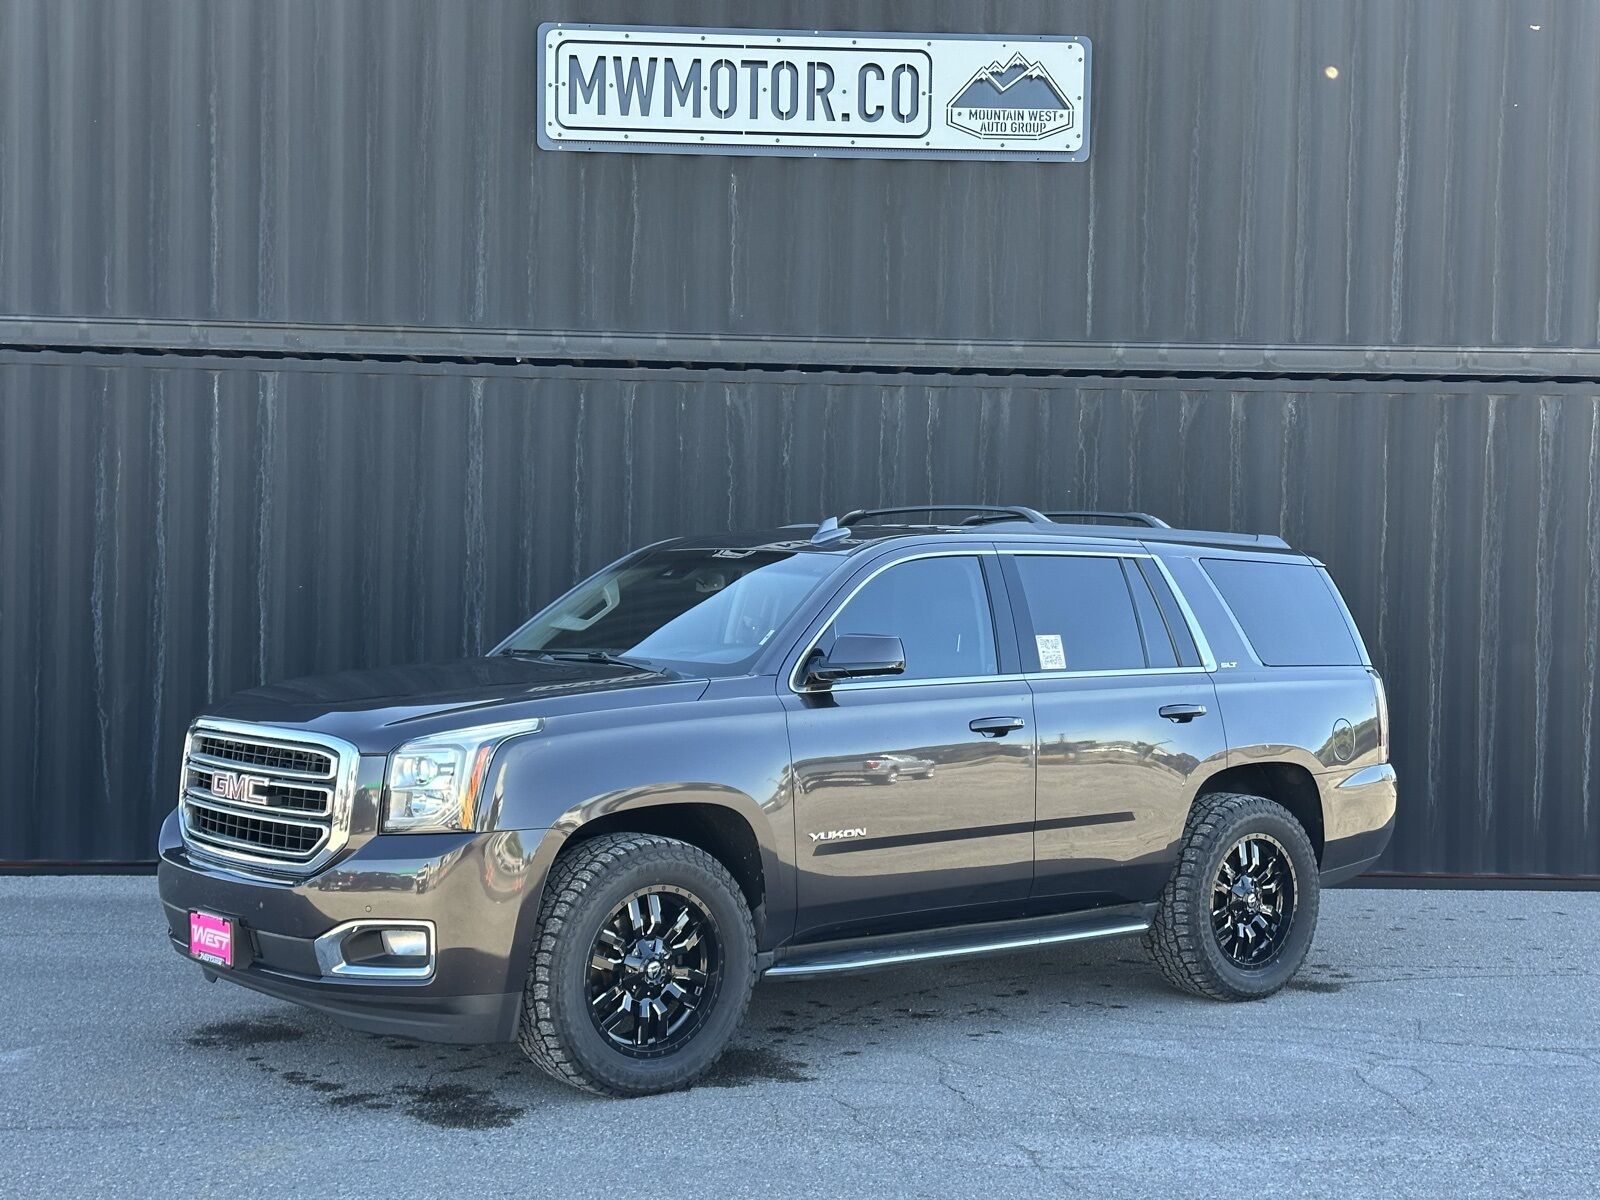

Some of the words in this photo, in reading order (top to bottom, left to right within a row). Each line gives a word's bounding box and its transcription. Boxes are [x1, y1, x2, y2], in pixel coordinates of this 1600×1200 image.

[568, 54, 920, 124] MWMOTOR.CO
[968, 109, 1024, 121] MOUNTAIN
[1028, 110, 1058, 122] WEST
[979, 121, 1007, 133] AUTO
[1010, 122, 1047, 133] GROUP
[211, 770, 270, 805] GMC
[808, 827, 867, 842] YUKON
[190, 924, 230, 951] WEST
